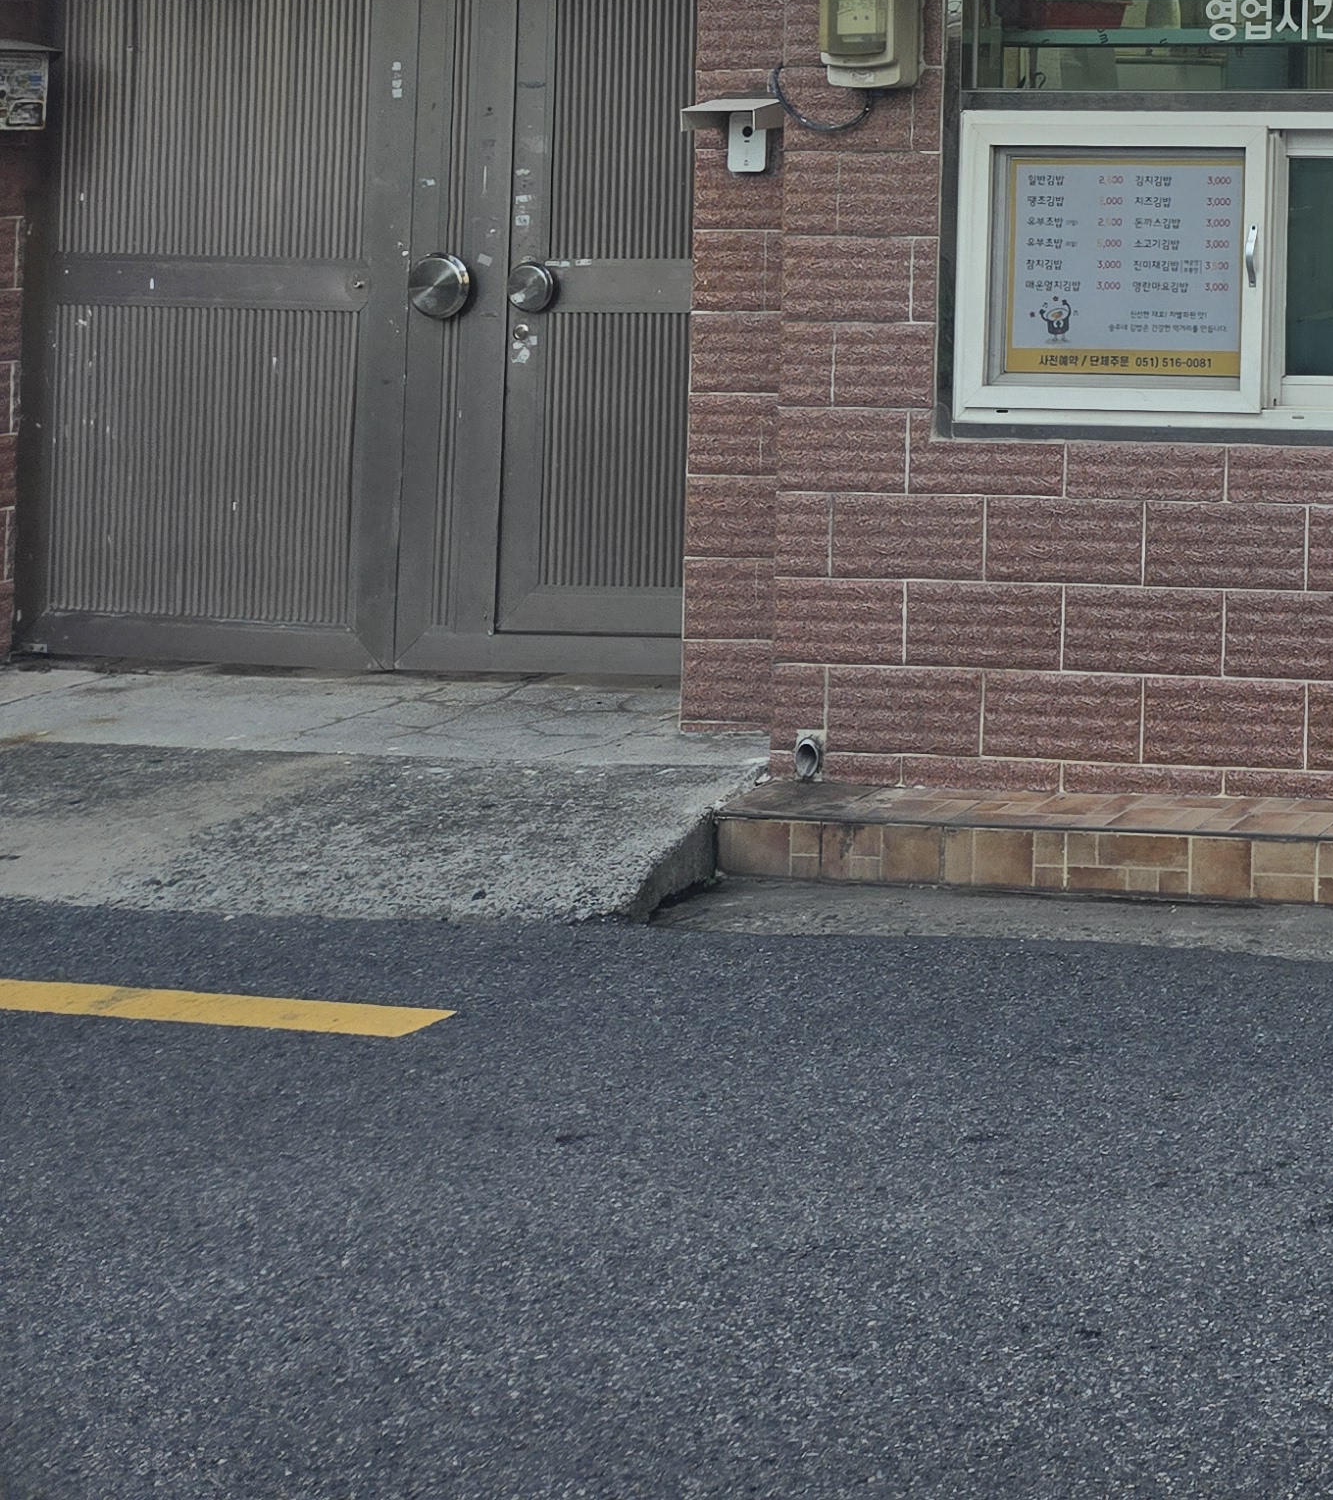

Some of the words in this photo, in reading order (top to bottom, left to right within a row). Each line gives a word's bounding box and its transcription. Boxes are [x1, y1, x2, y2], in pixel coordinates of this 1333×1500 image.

[1028, 174, 1065, 186] 일반김밥
[1135, 175, 1172, 187] 김치김밥
[1207, 175, 1232, 186] 3,000
[1134, 196, 1172, 208] 치즈김밥
[1206, 197, 1231, 207] 3,000
[1205, 218, 1231, 228] 3,000
[1133, 238, 1180, 251] 소고기김밥
[1205, 239, 1230, 250] 3,000
[1025, 259, 1062, 271] 참치김밥
[1096, 260, 1122, 269] 3,000
[1096, 281, 1121, 291] 3,000
[1204, 282, 1229, 292] 3,000
[1039, 355, 1078, 366] 사전예약
[1089, 355, 1130, 367] 단체주문
[1162, 357, 1212, 368] 516-0081
